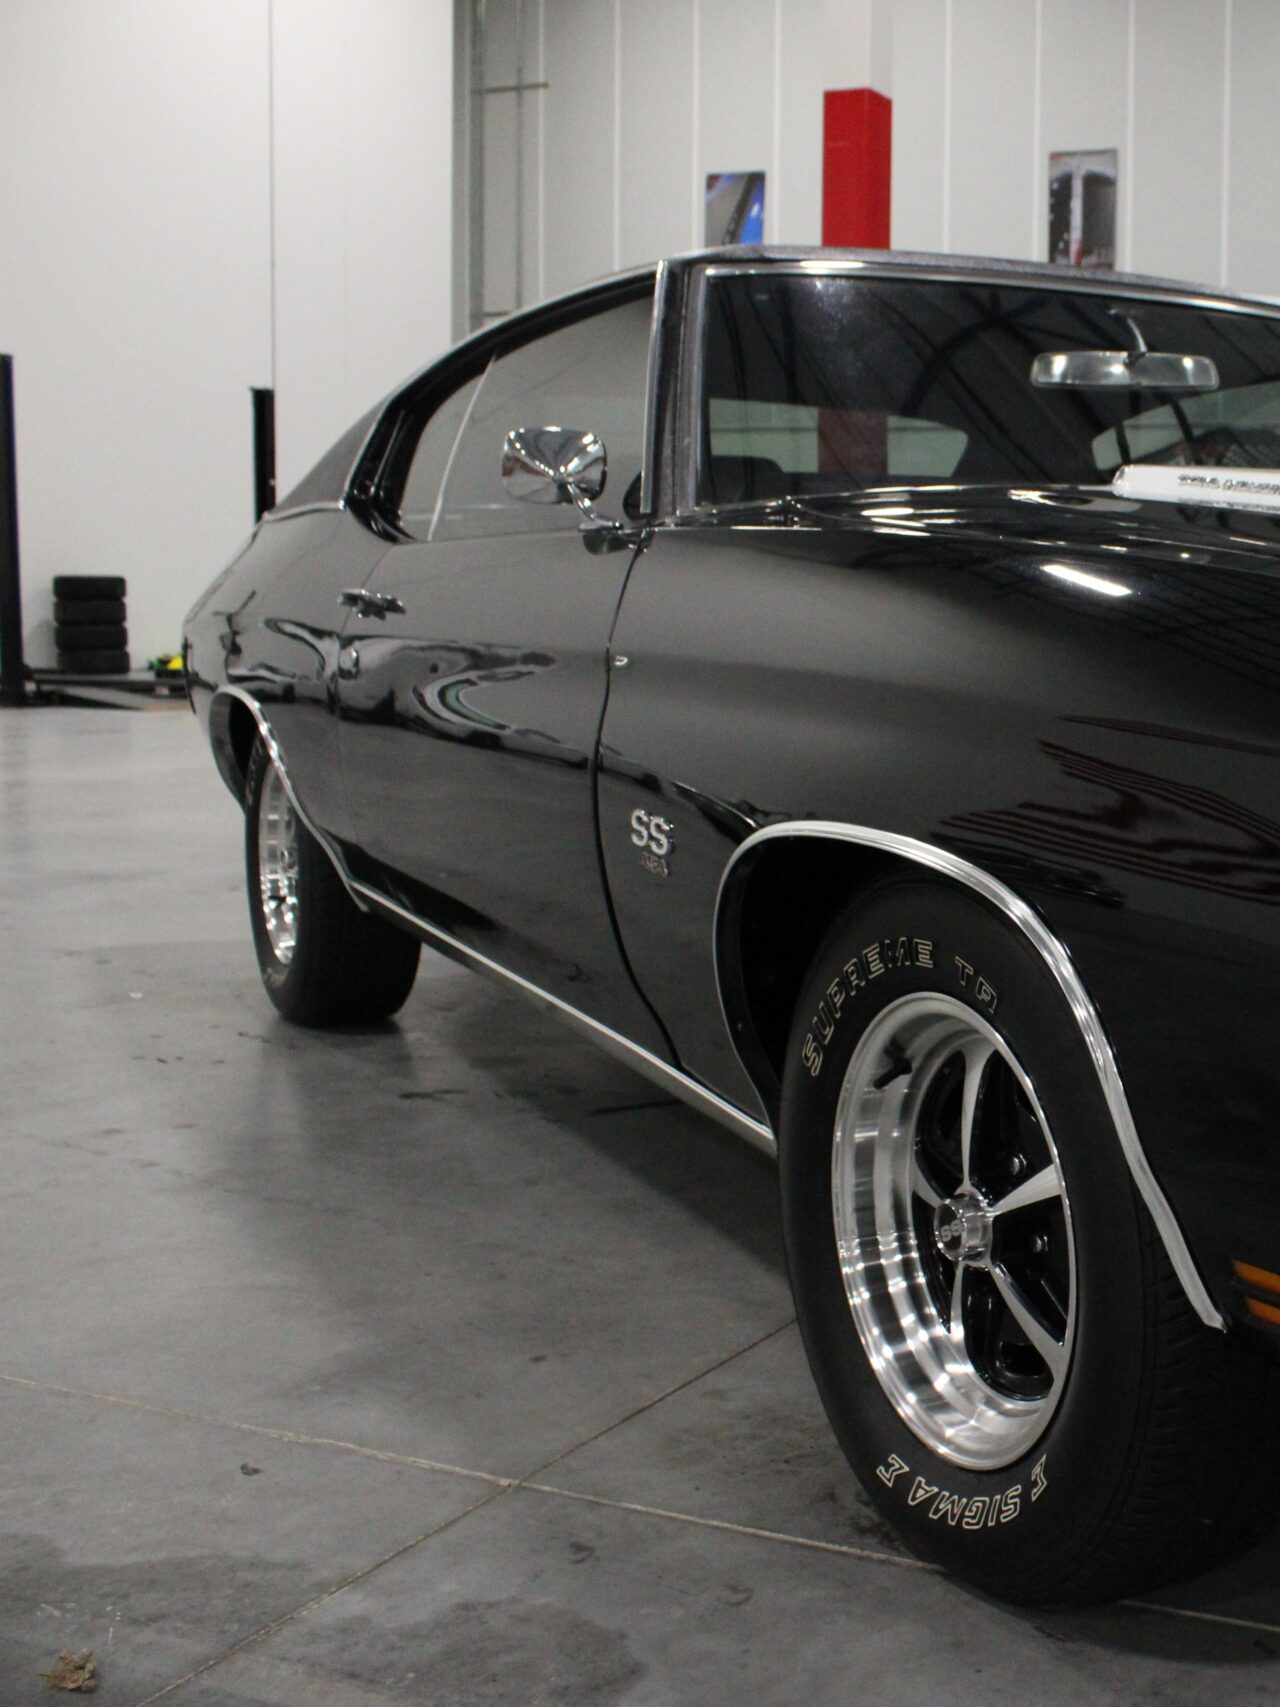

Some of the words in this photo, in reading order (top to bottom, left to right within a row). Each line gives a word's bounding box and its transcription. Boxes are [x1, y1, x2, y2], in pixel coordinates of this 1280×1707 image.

[630, 808, 671, 856] SS
[802, 937, 934, 1077] SUPREME
[907, 1476, 1023, 1530] SIGMA
